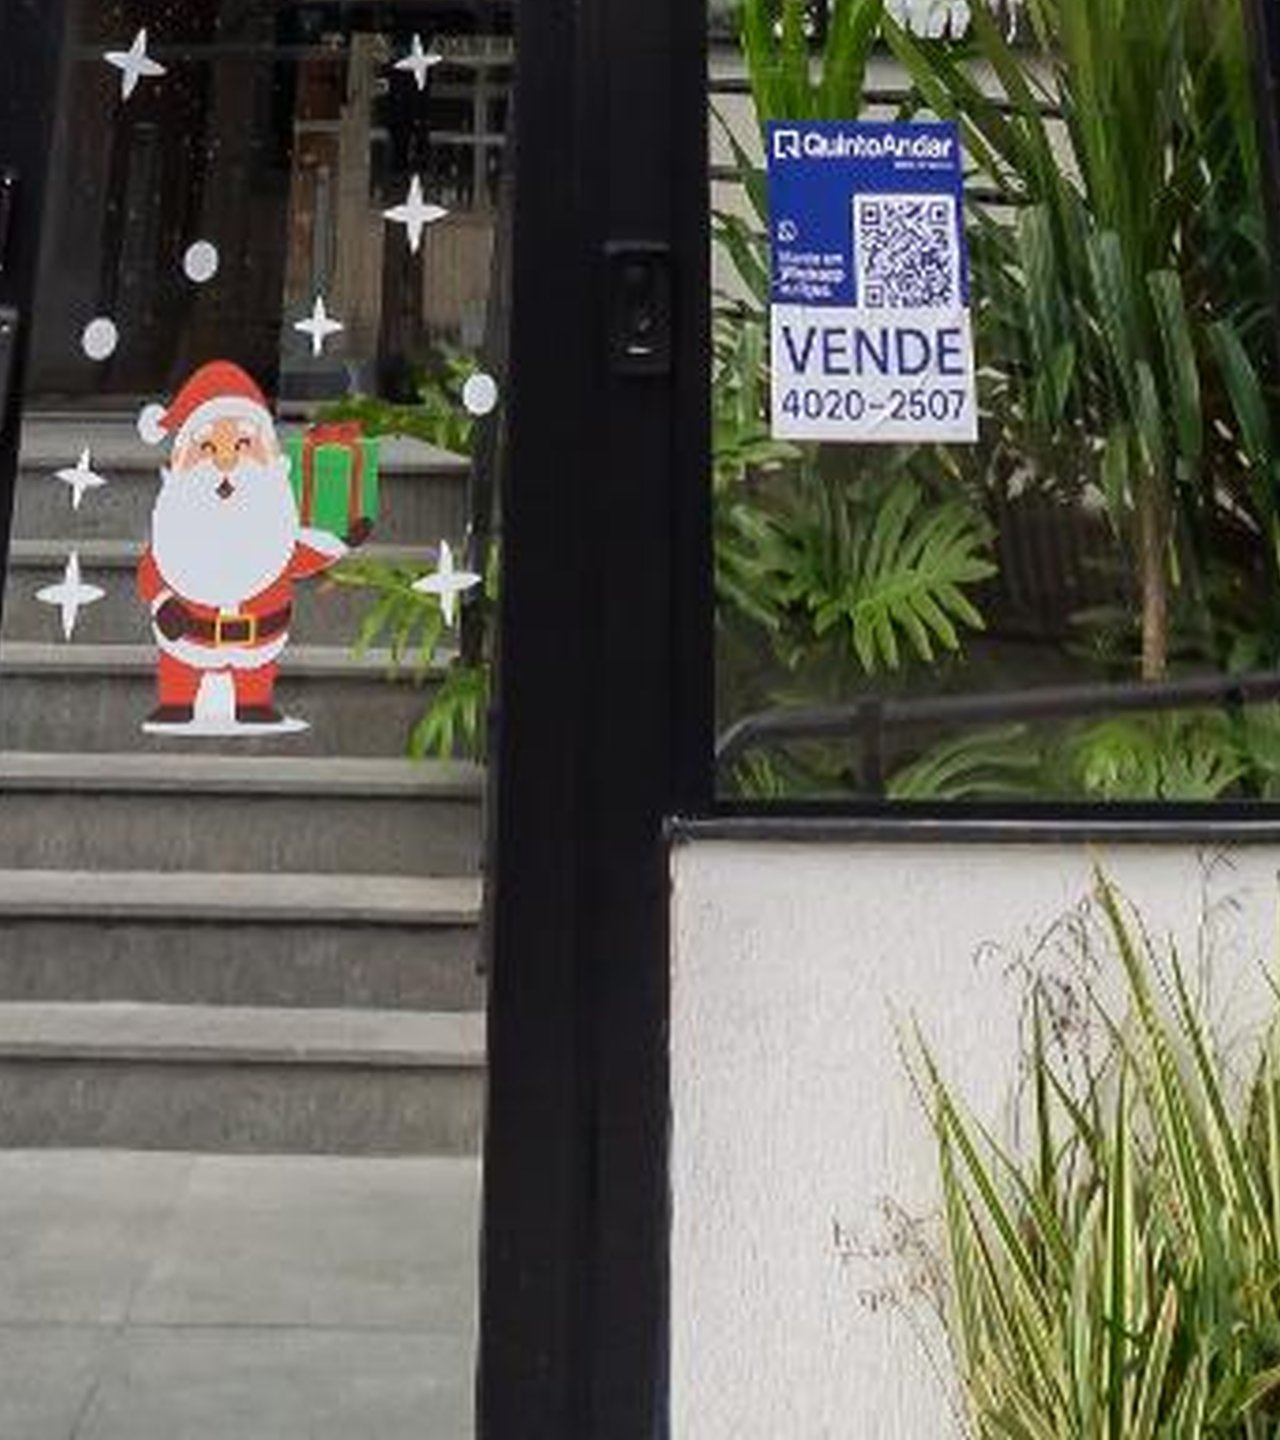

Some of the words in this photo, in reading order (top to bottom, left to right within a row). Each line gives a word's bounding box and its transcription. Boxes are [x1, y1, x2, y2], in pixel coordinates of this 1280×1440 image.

[803, 133, 953, 158] QuintoAndar
[782, 326, 964, 376] VENDE
[782, 388, 965, 421] 4020-2507
